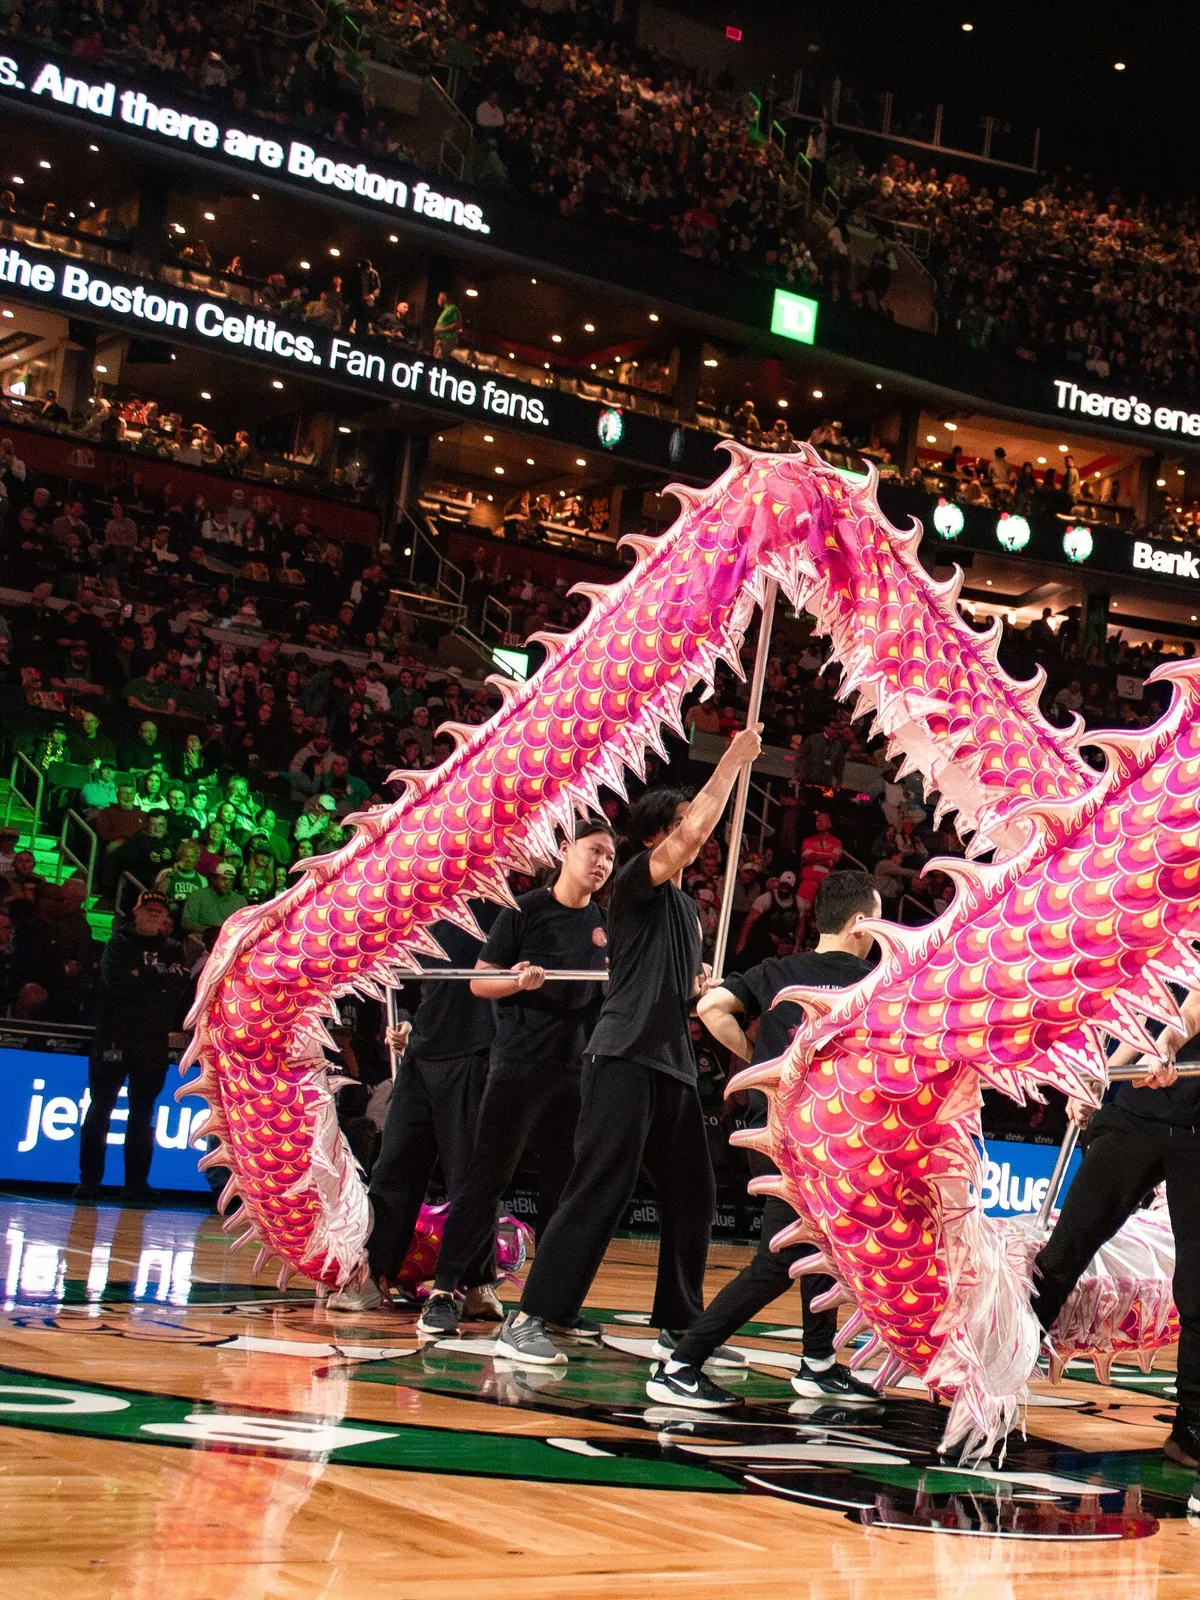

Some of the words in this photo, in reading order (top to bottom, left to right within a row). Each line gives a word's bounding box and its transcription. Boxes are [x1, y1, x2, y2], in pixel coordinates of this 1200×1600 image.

[31, 63, 116, 117] And
[120, 90, 219, 148] there
[223, 129, 284, 168] are
[288, 141, 408, 208] Boston
[413, 182, 490, 234] fans.
[0, 248, 56, 292] the
[62, 264, 189, 329] Boston
[195, 302, 322, 366] Celtics.
[329, 338, 385, 382] Fan
[391, 361, 424, 391] of
[428, 366, 476, 405] the
[483, 381, 550, 426] fans.
[1054, 380, 1152, 426] There's
[1134, 541, 1200, 579] Bank
